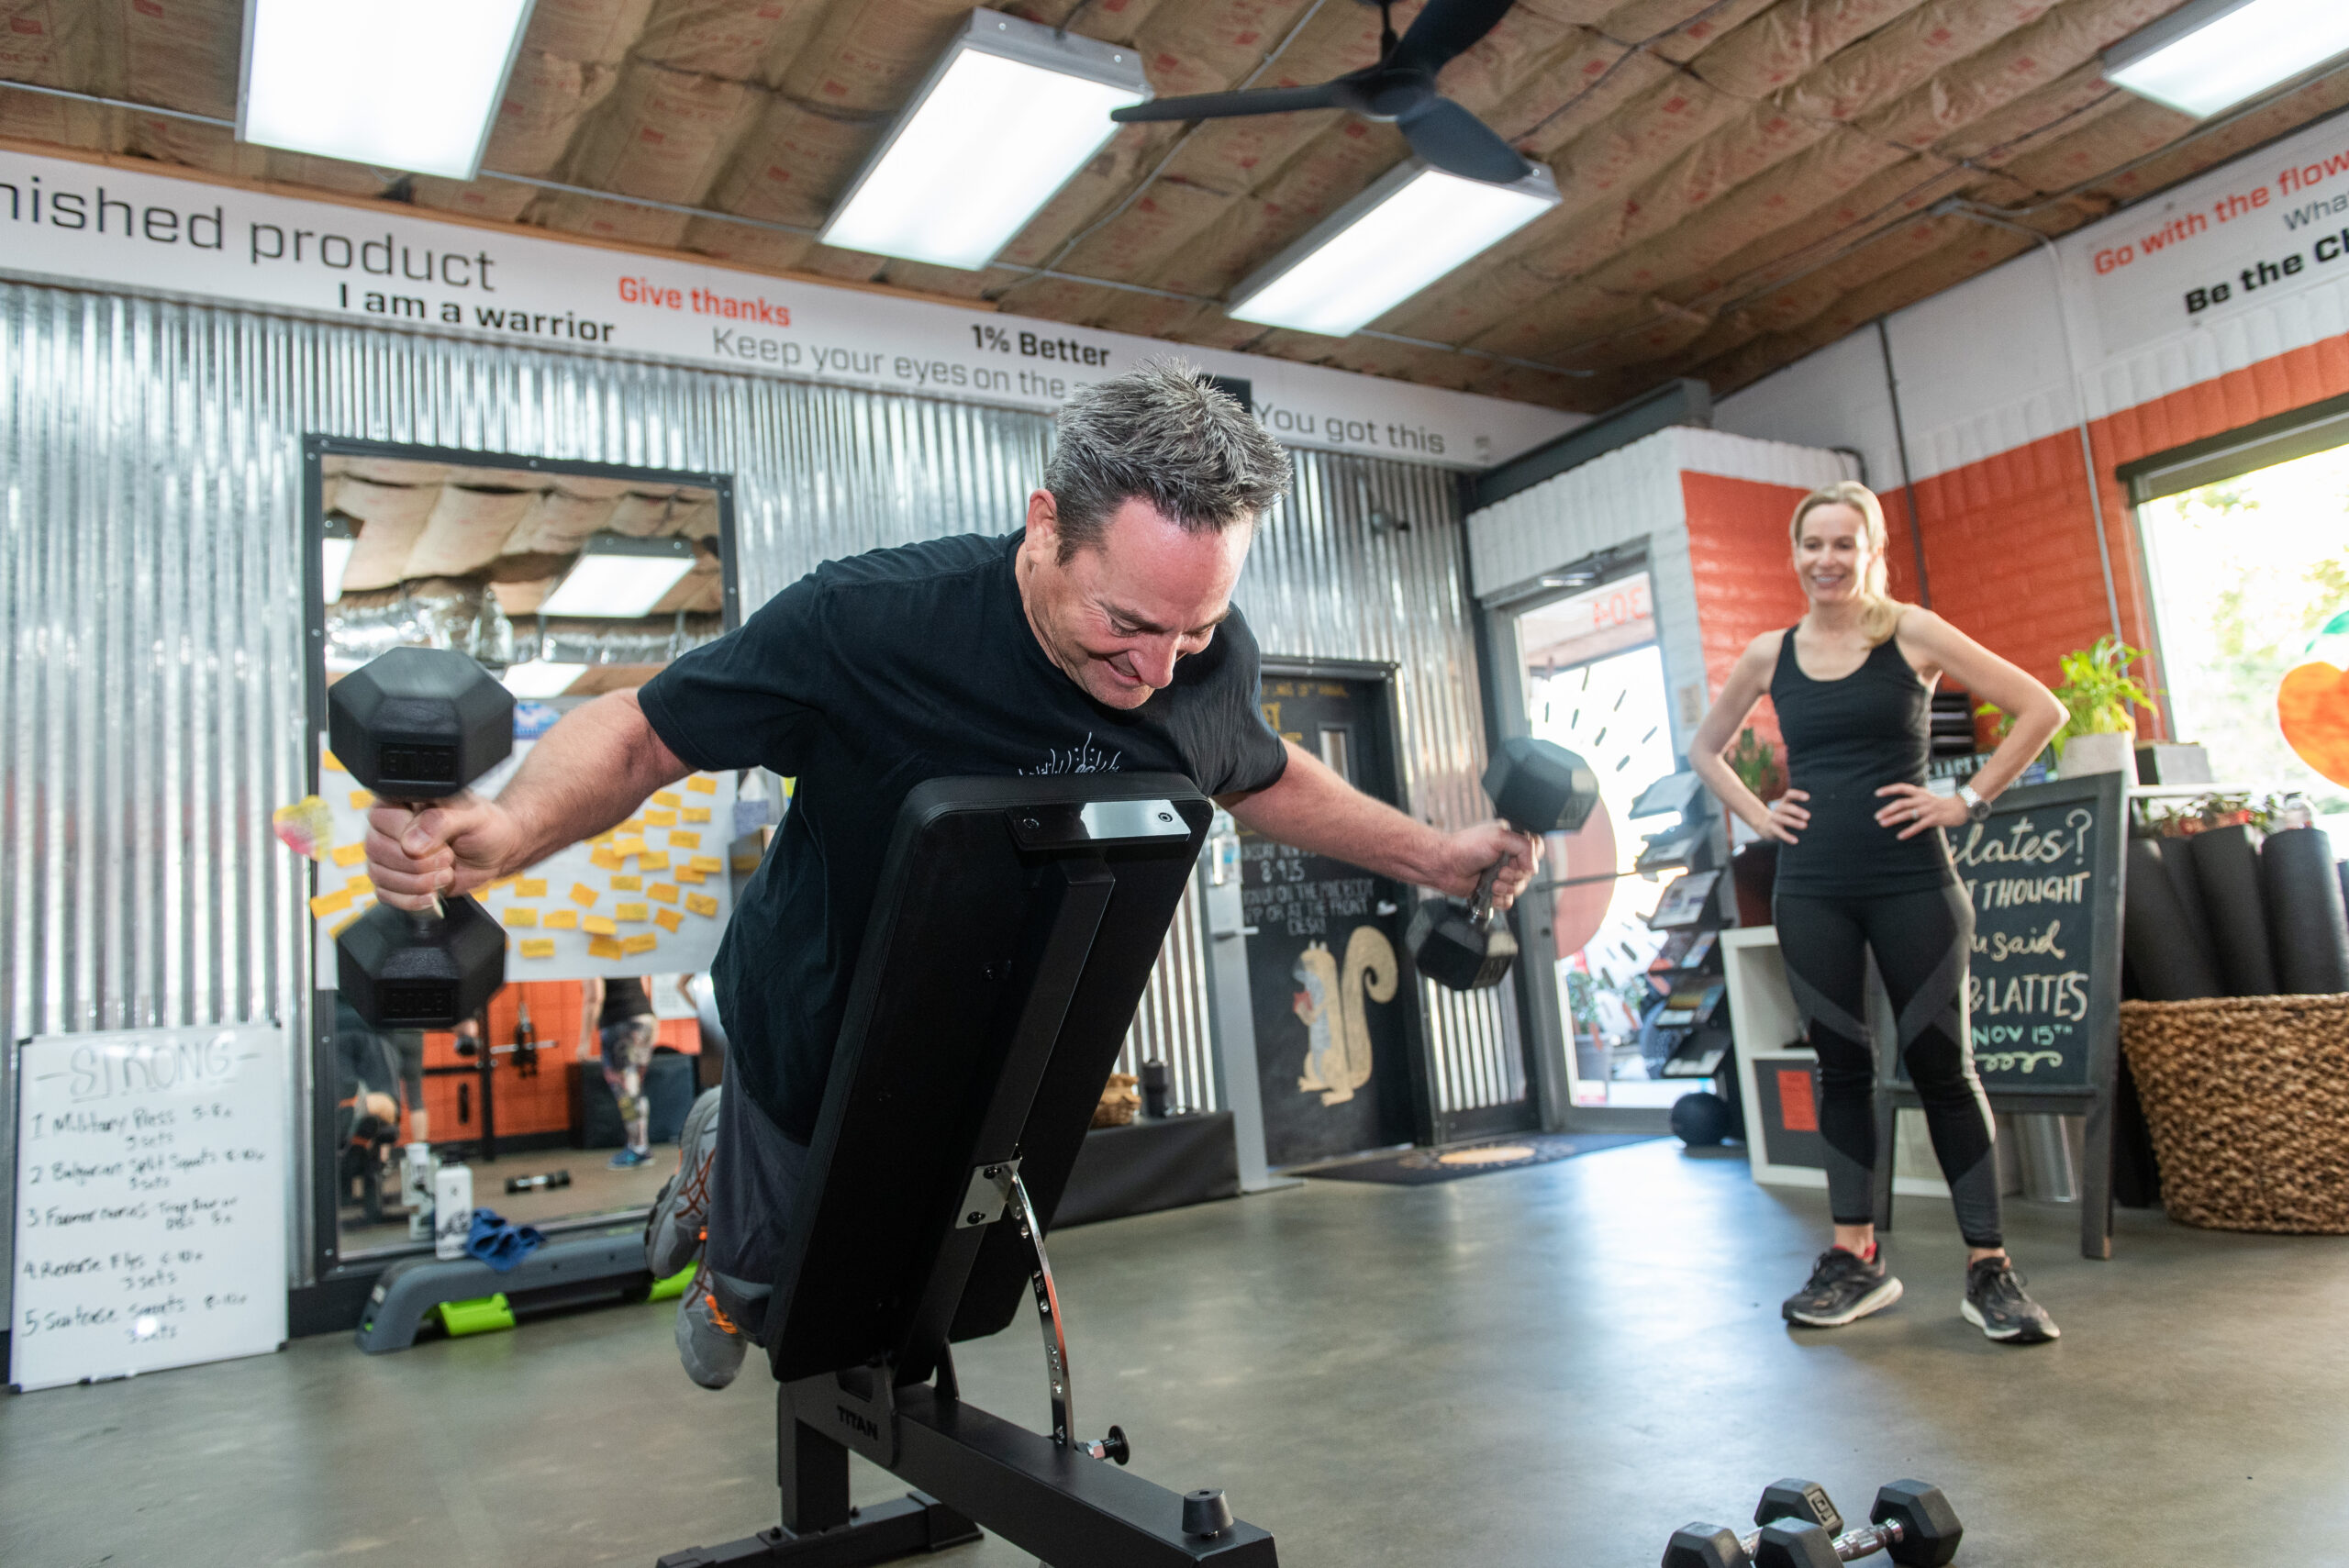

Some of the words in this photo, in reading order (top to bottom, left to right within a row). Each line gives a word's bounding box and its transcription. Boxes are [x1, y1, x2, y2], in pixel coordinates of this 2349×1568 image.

[2094, 244, 2134, 275] Go
[2141, 212, 2208, 256] with
[2214, 186, 2270, 224] the
[2277, 150, 2349, 197] flow
[2283, 189, 2349, 231] Wha
[250, 222, 496, 292] product
[618, 277, 683, 310] Give
[691, 291, 791, 328] thanks
[2185, 282, 2232, 315] Be
[2241, 253, 2304, 292] the
[339, 283, 348, 308] I
[364, 291, 426, 319] am
[441, 304, 461, 323] a
[475, 307, 616, 343] warrior
[713, 327, 801, 367] Keep
[810, 345, 884, 375] your
[894, 356, 967, 391] eyes
[974, 366, 1010, 392] on
[1017, 369, 1065, 400] the
[971, 323, 1010, 353] 1%
[1019, 330, 1110, 368] Better
[1251, 400, 1314, 435] You
[1326, 417, 1378, 445] got
[1387, 422, 1446, 455] this
[1951, 808, 2093, 867] ilates?
[1982, 871, 2091, 911] THOUGHT
[1990, 918, 2066, 962] said
[1971, 1024, 2024, 1051] NOV
[836, 1405, 879, 1442] TITAN
